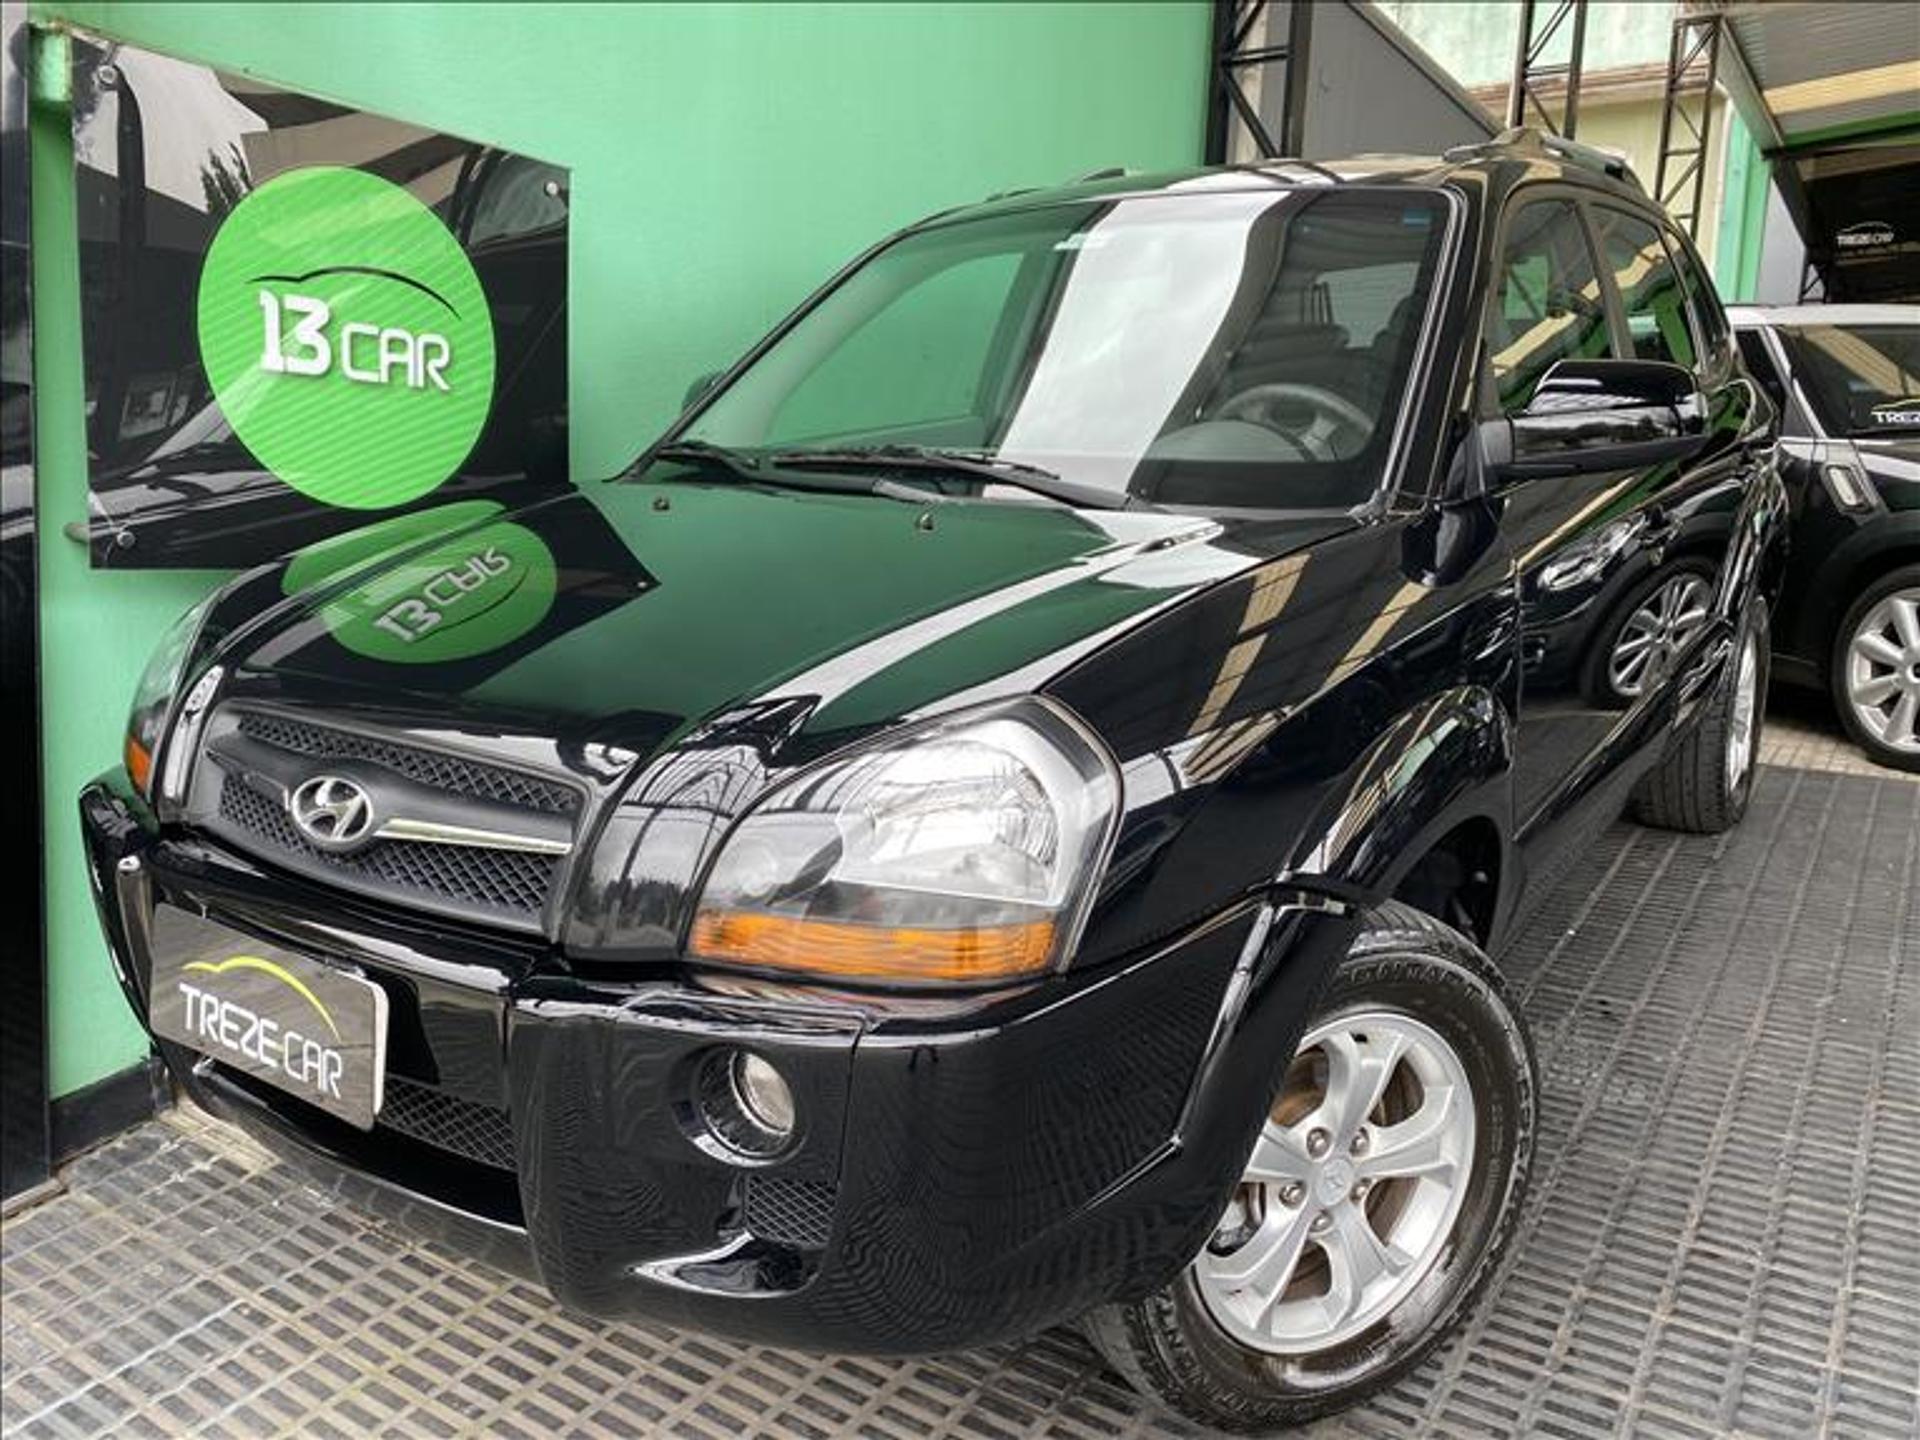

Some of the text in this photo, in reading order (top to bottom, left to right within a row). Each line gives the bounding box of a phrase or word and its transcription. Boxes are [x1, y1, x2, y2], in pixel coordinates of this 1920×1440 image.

[259, 288, 450, 391] 13 CAR
[179, 982, 343, 1099] TREZE CAR
